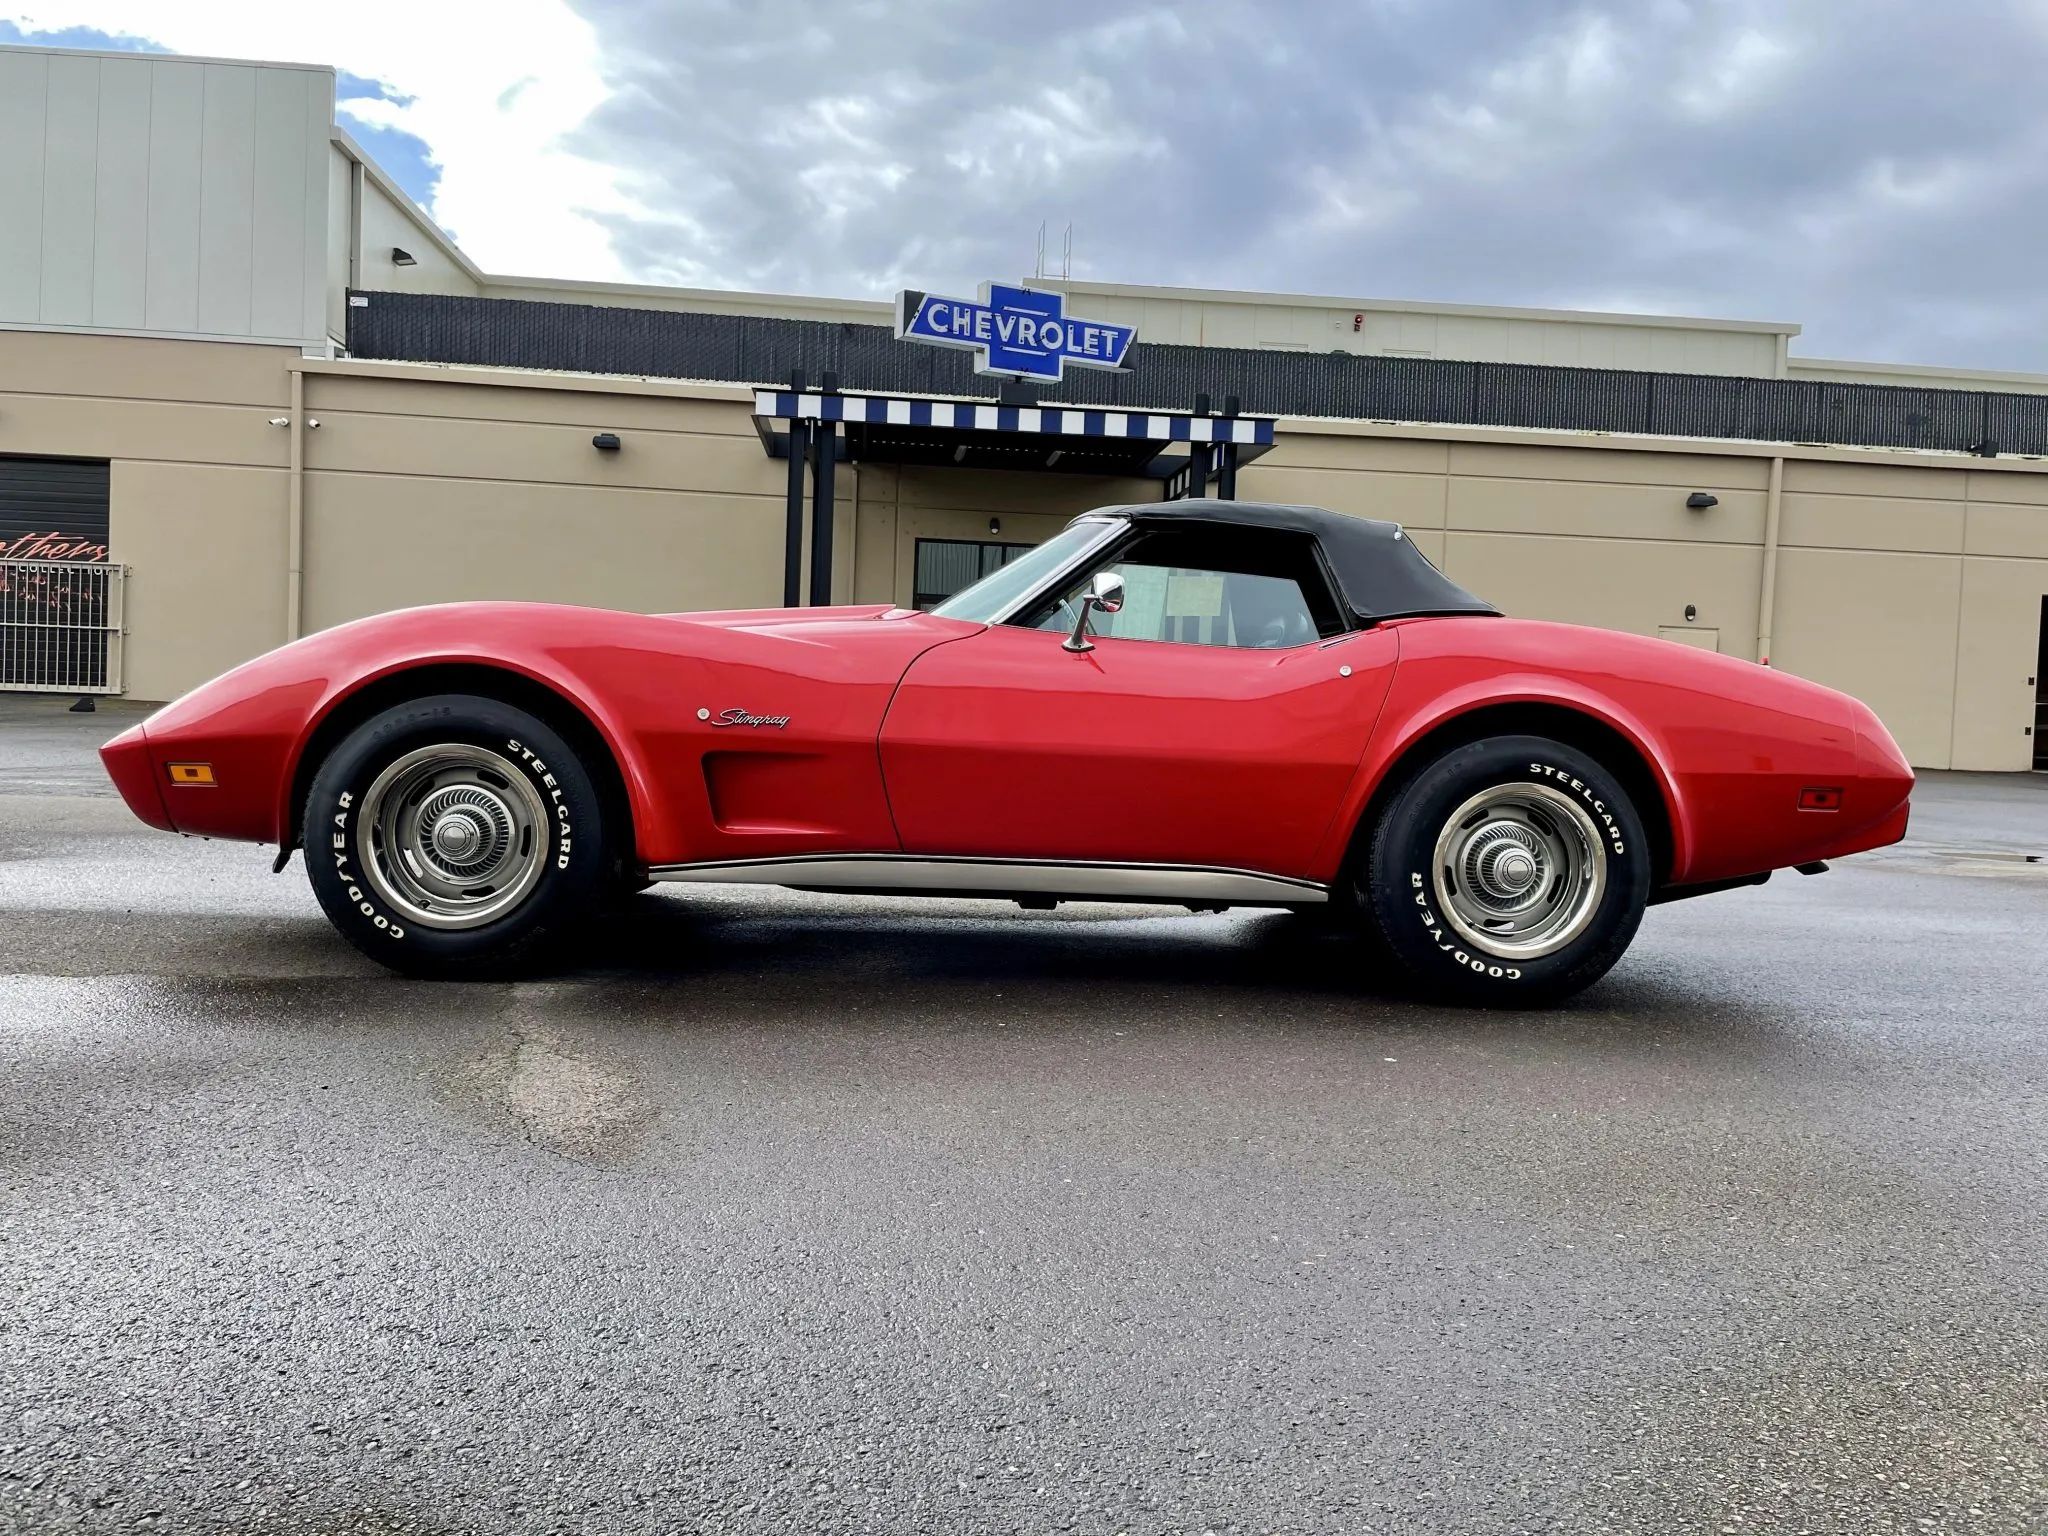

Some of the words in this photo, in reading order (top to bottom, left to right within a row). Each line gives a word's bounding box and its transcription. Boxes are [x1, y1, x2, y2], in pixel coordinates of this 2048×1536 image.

[927, 303, 1118, 358] CHEVROLET
[711, 708, 790, 728] Stingray
[507, 739, 571, 869] STEELGARD
[1530, 763, 1624, 855] STEELGARD
[333, 791, 404, 939] GOODYEAR
[1411, 872, 1521, 980] GOODYEAR
